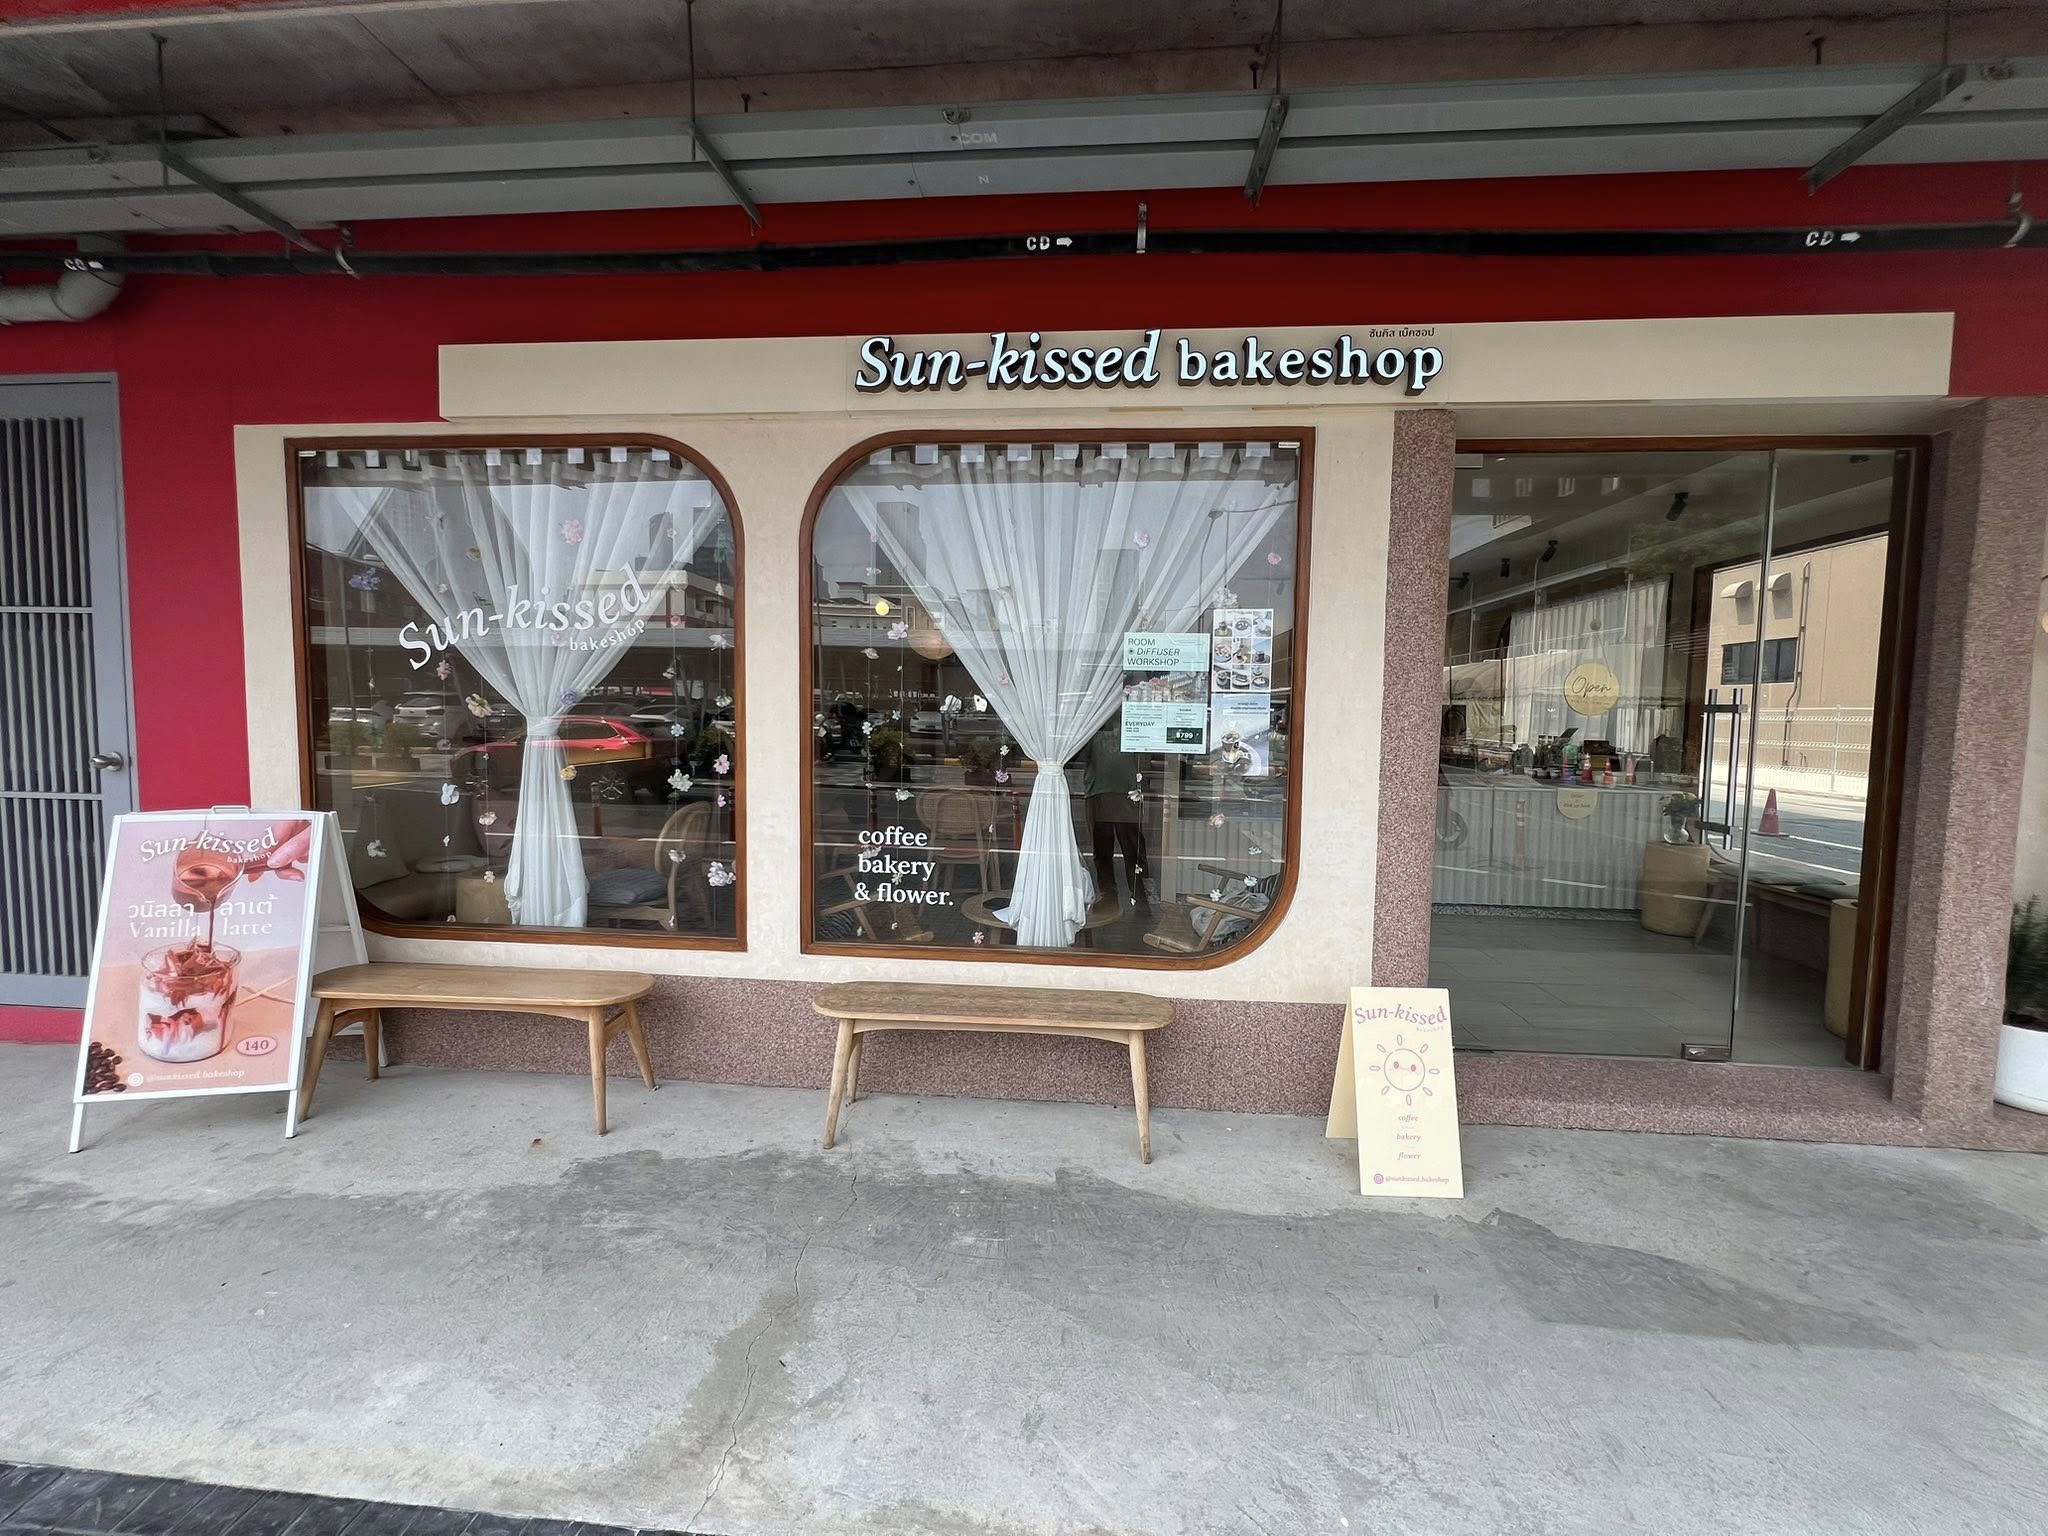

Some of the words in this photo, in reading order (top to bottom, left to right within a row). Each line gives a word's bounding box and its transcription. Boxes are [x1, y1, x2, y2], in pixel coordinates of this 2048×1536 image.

[1027, 236, 1050, 251] CD
[1806, 230, 1834, 247] CD
[855, 329, 1163, 393] Sun-kissed
[1177, 334, 1443, 396] bakeshop
[398, 561, 651, 671] Sun-kissed
[569, 617, 646, 652] bakeshop
[1127, 637, 1156, 647] ROOM
[1127, 657, 1180, 667] WORKSHOP
[1571, 675, 1612, 699] Open
[1125, 720, 1156, 728] EVERYDAY
[140, 826, 280, 863] Sun-kissed
[858, 825, 929, 847] coffee
[858, 853, 937, 882] bakery
[219, 893, 279, 915] ลาเต้
[854, 882, 871, 902] &
[876, 882, 954, 907] flower.
[129, 918, 201, 939] Vanilla
[222, 917, 273, 937] latte
[1354, 1003, 1448, 1026] Sun-kissed
[244, 1039, 269, 1052] 140
[1397, 1113, 1420, 1123] coffee
[1396, 1133, 1422, 1143] bakery
[1397, 1151, 1422, 1161] flower
